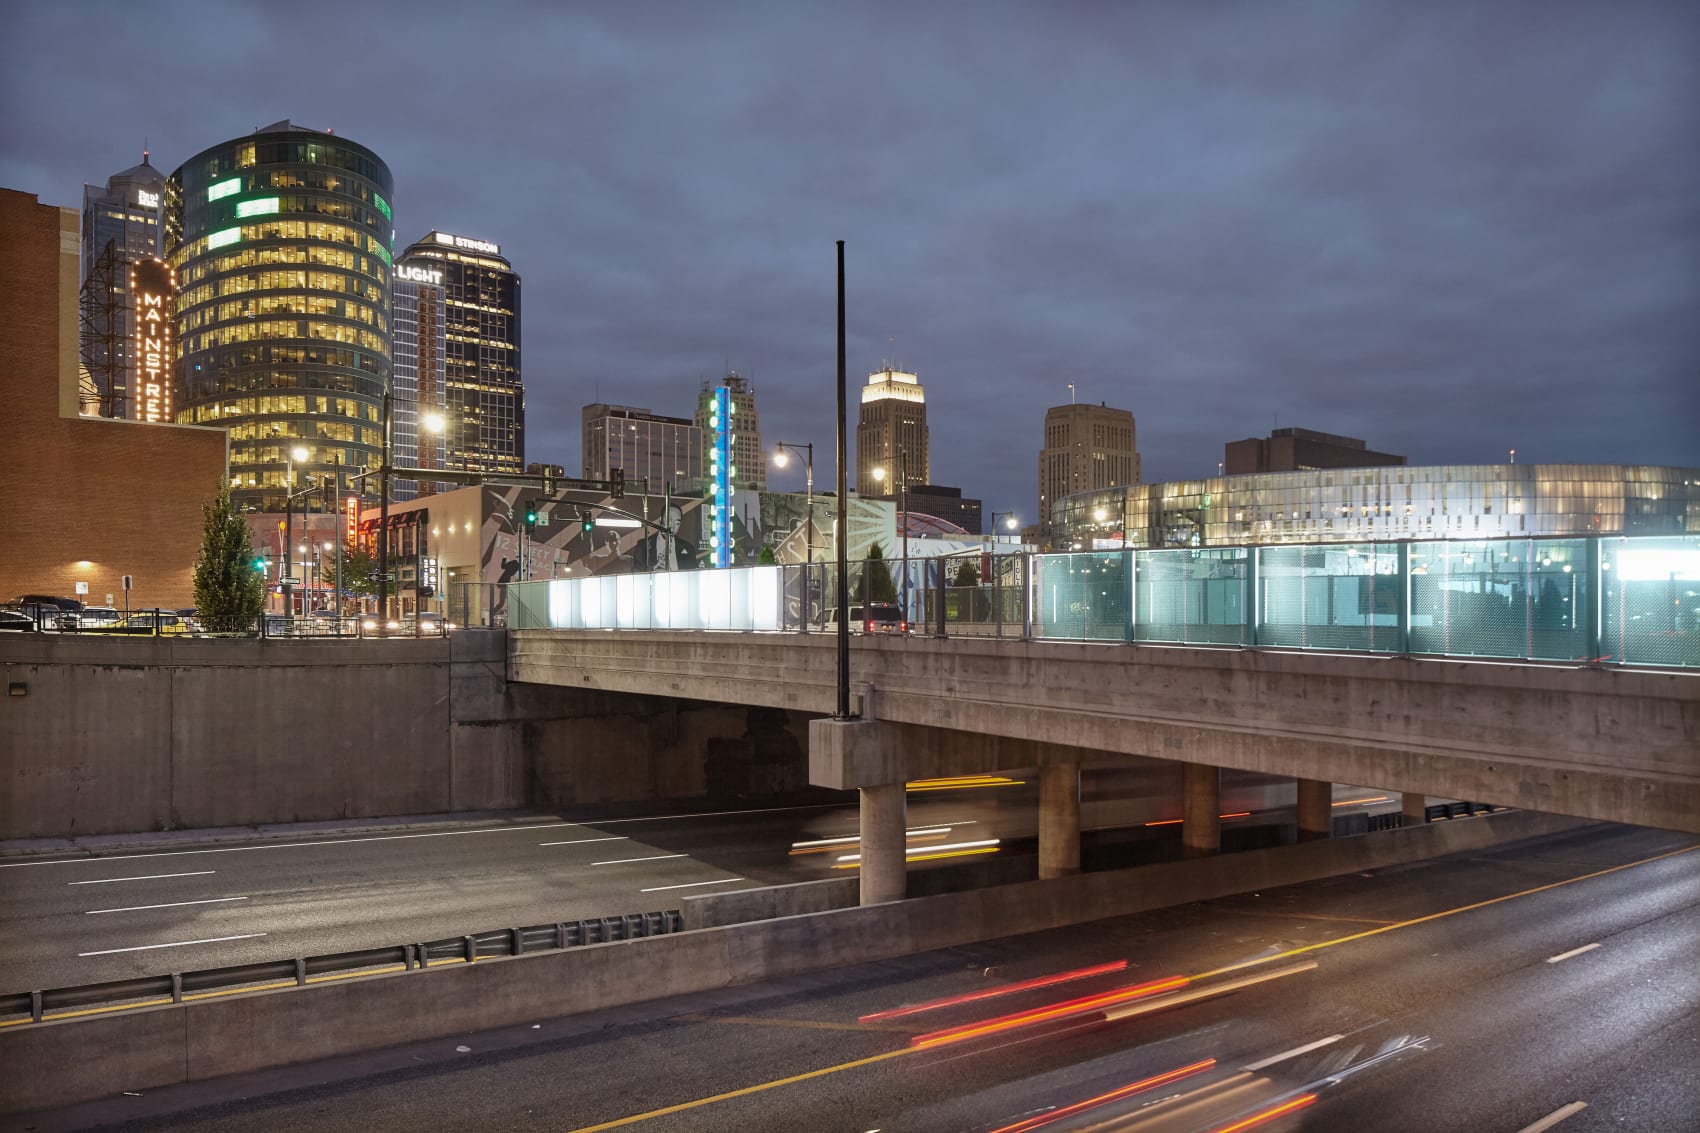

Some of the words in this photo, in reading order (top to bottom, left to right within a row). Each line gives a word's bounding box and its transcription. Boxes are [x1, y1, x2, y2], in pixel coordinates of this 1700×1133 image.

[455, 236, 498, 254] STINSON
[397, 264, 442, 284] LIGHT
[495, 535, 511, 550] 12
[514, 541, 550, 560] SREET
